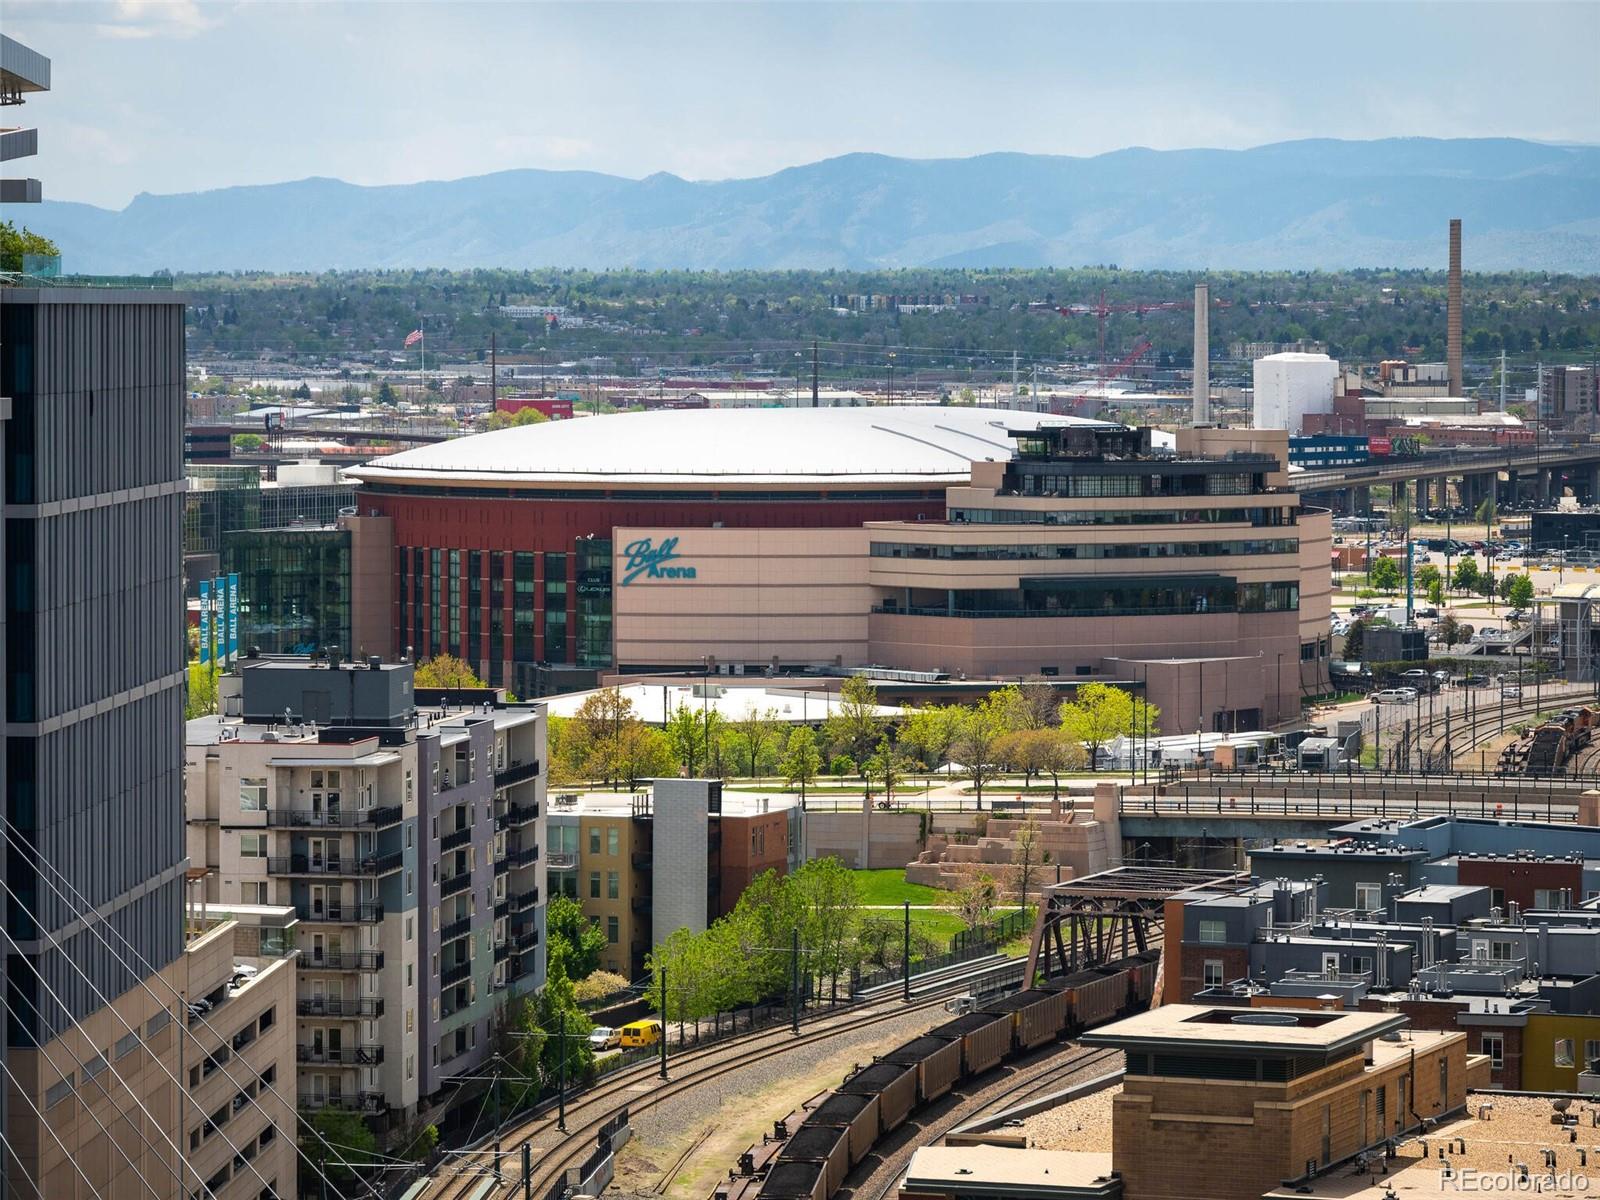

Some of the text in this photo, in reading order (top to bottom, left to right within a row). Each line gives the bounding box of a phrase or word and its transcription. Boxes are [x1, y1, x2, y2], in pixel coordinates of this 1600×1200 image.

[623, 536, 681, 588] Ball
[647, 562, 697, 579] Arena
[201, 592, 209, 649] BALL ARENA
[217, 588, 225, 644] BALL ARENA
[229, 584, 237, 640] BALL ARENA
